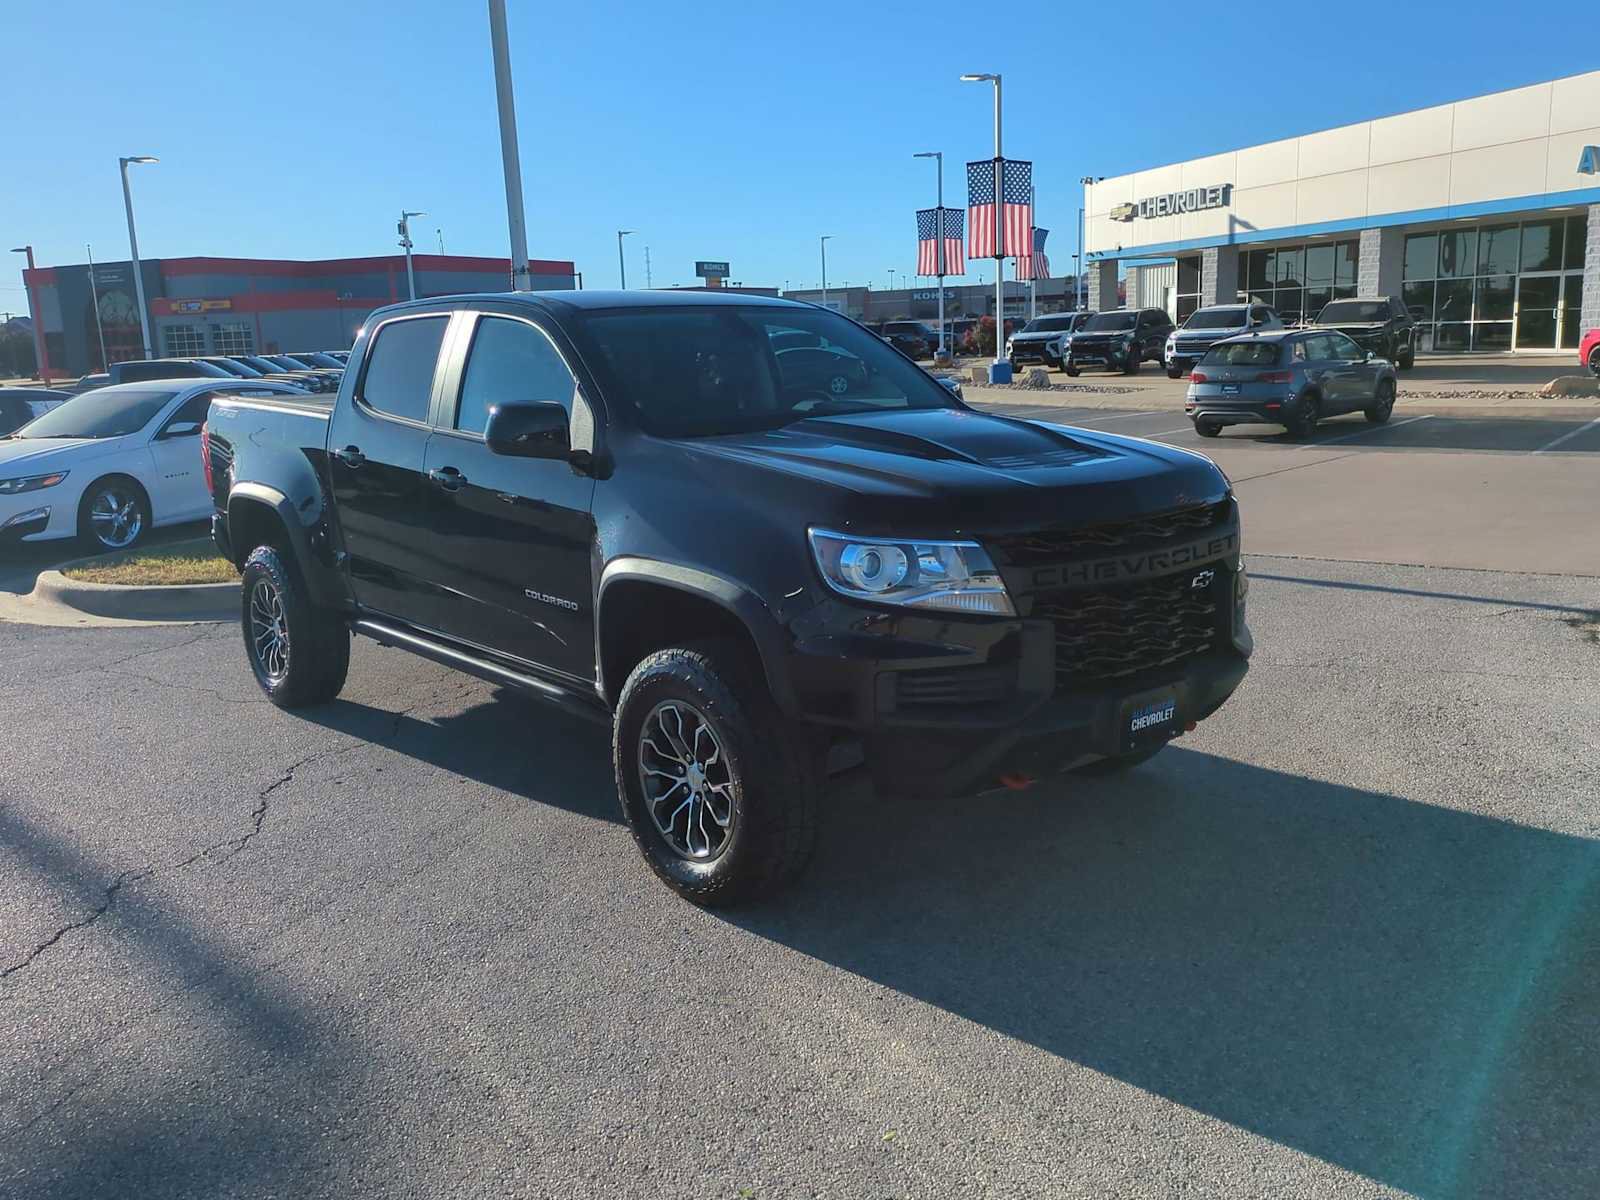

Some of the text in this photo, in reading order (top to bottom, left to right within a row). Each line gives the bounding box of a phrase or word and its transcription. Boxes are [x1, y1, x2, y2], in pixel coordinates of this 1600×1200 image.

[1137, 184, 1233, 219] CHEVROLET
[1033, 535, 1237, 587] CHEVROLET
[524, 588, 579, 611] COLORADO
[1131, 707, 1175, 731] CHEVROLET
